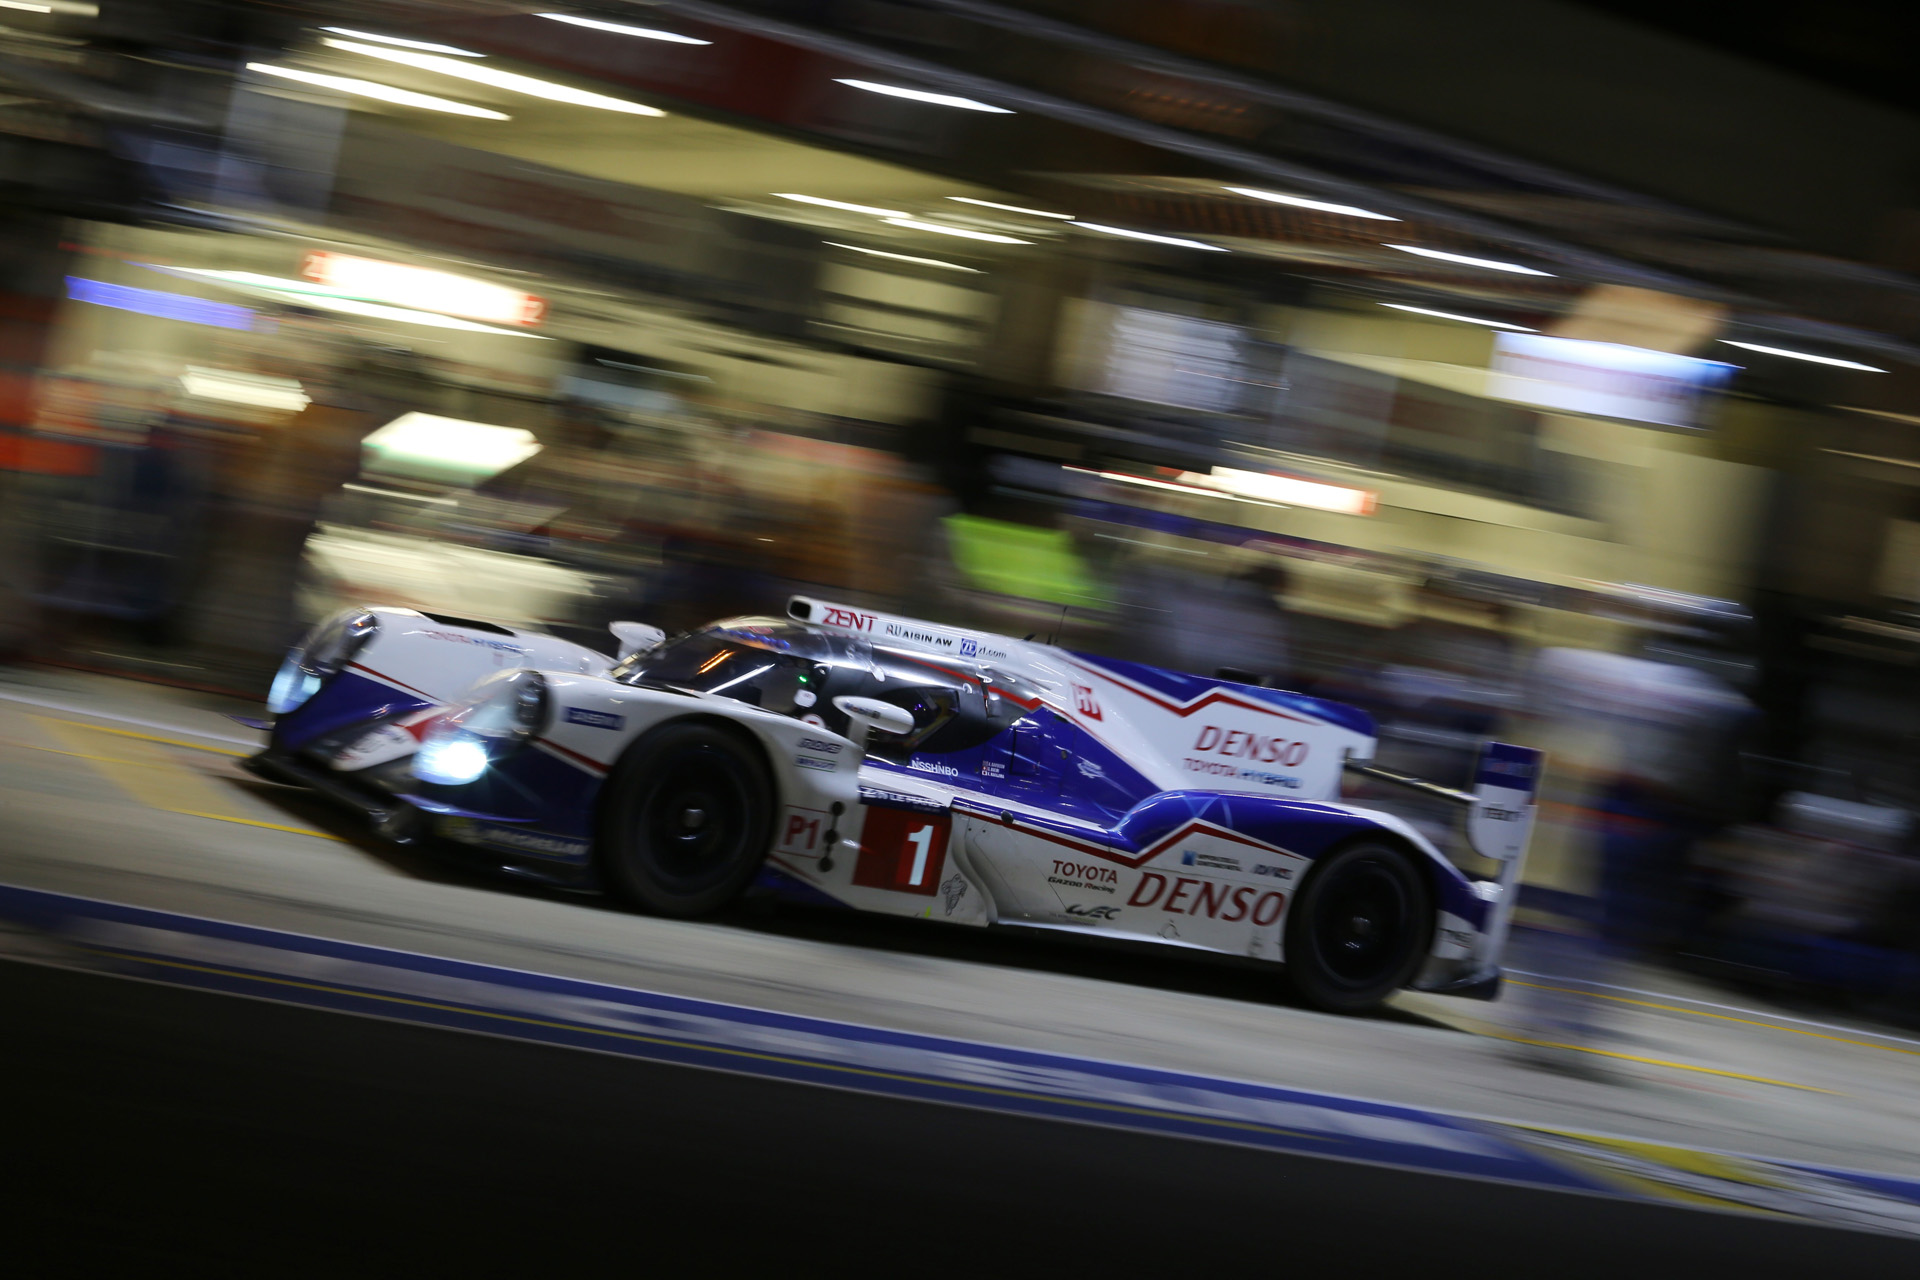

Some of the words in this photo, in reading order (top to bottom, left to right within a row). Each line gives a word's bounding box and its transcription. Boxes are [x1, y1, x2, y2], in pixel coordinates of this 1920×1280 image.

[824, 608, 877, 632] ZENT
[902, 630, 933, 644] AISIN
[935, 637, 953, 647] AW
[1193, 725, 1310, 767] DENSO
[1182, 757, 1238, 778] TOYOTA
[785, 814, 820, 849] P1
[908, 825, 934, 886] 1
[1053, 860, 1117, 884] TOYOTA
[1127, 871, 1286, 926] DENSO
